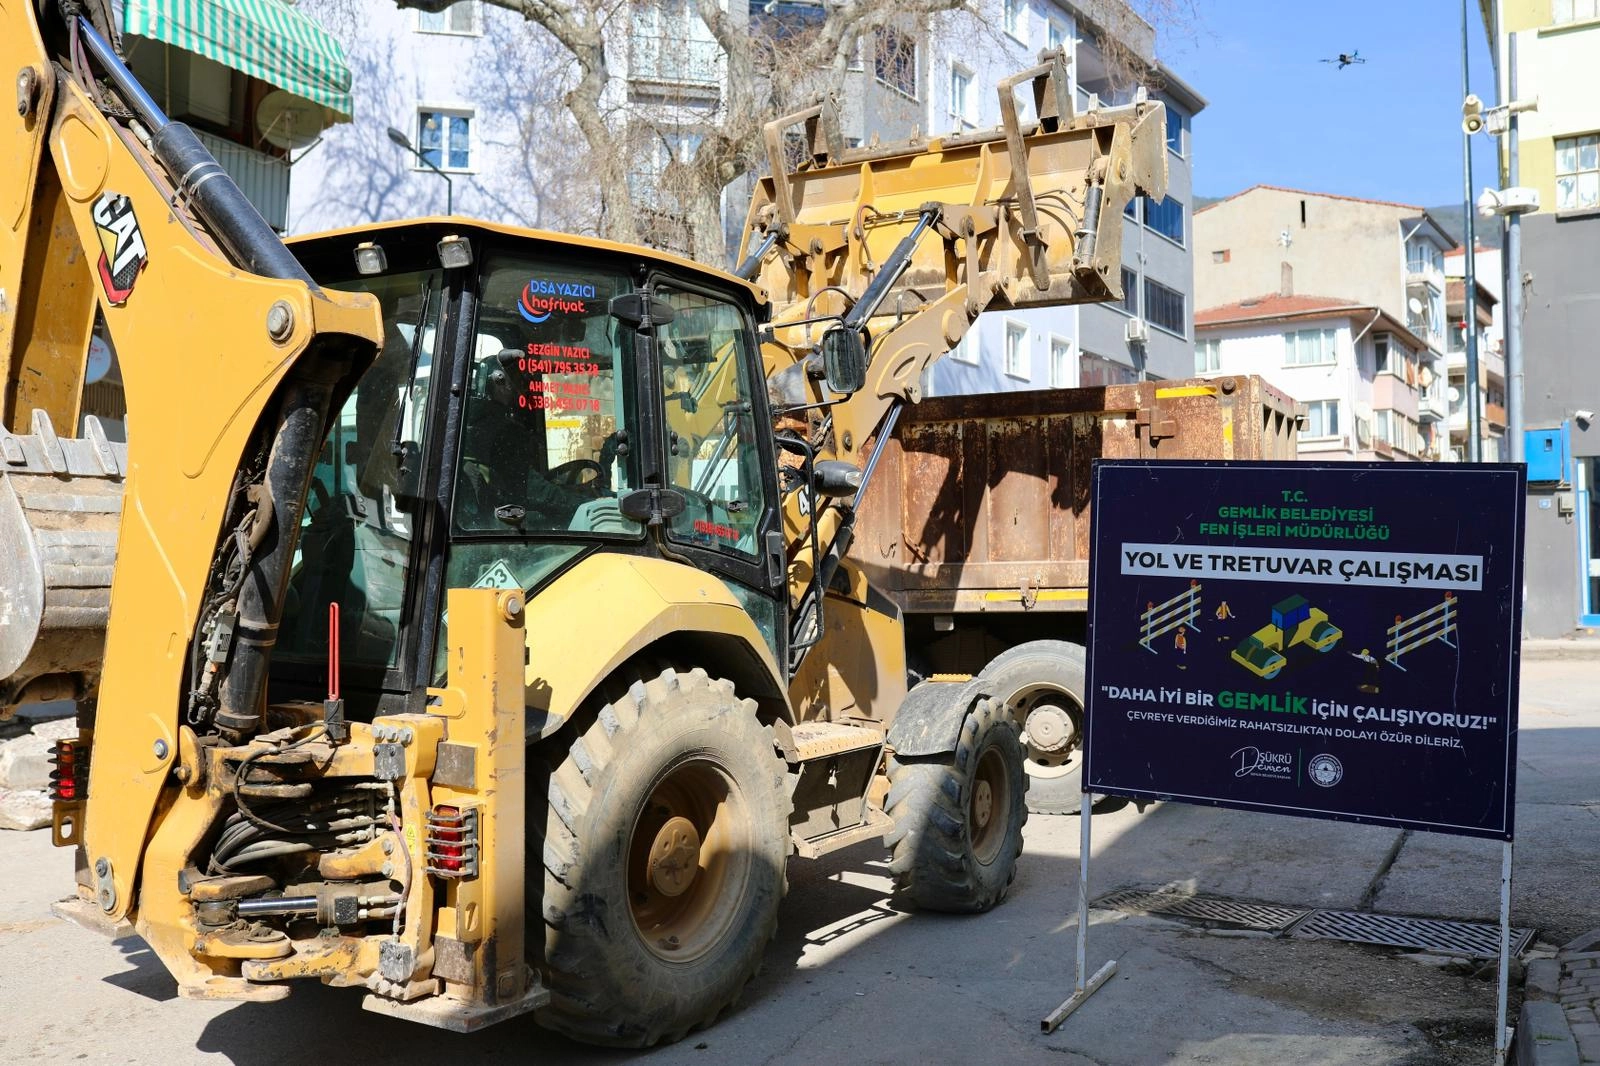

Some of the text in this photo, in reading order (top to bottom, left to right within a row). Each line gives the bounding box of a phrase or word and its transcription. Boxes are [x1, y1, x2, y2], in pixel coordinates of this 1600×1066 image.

[93, 195, 147, 277] CAT
[527, 343, 590, 359] SEZGİN YAZICI
[518, 358, 526, 371] 0
[527, 358, 552, 375] (541)
[553, 361, 572, 374] 795
[573, 362, 585, 375] 35
[518, 395, 527, 408] 0
[1281, 490, 1308, 502] T.C.
[1218, 504, 1373, 522] GEMLİK BELEDİYESİ
[1200, 520, 1390, 540] FEN İŞLERİ MÜDÜRLÜĞÜ
[1125, 551, 1478, 584] YOL VE TRETUVAR ÇALIŞMASI
[1101, 685, 1497, 730] "DAHA İYİ BİR GEMLİK İÇİN ÇALIŞIYORUZ!"
[1127, 710, 1464, 749] ÇEVREYE VERDİĞİMİZ RAHATSIZLIKTAN DOLAYI ÖZÜR DİLERİZ.
[1259, 752, 1292, 765] ŞÜKRÜ
